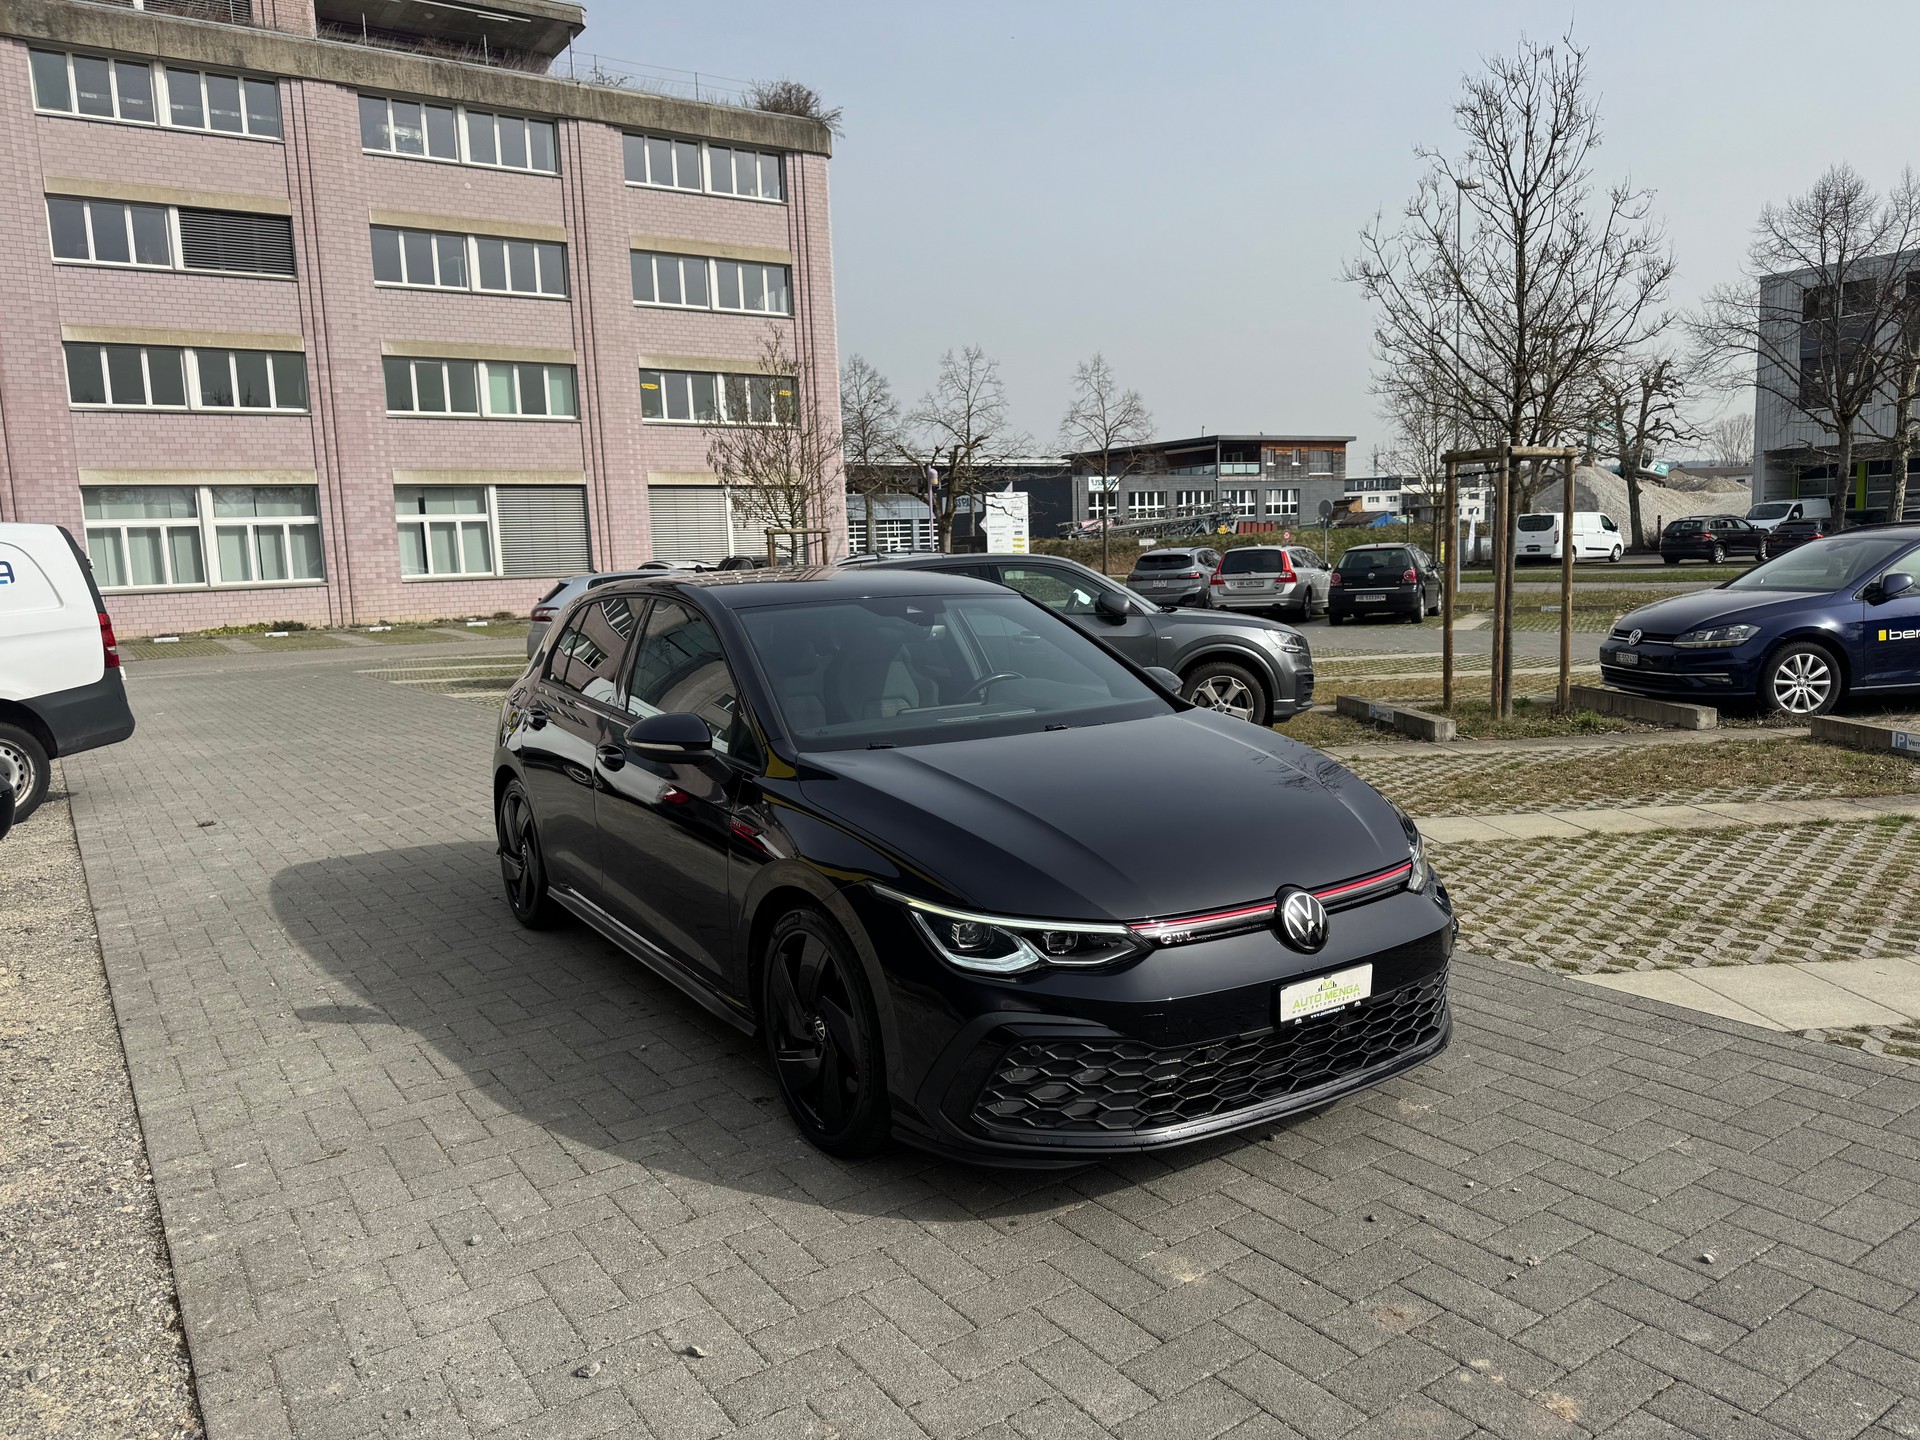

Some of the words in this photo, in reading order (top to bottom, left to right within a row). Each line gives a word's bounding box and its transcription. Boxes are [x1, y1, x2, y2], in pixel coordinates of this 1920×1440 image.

[1898, 734, 1905, 747] P
[1160, 931, 1191, 945] GTI
[1293, 993, 1322, 1010] AUTO
[1324, 983, 1361, 1002] MENGA
